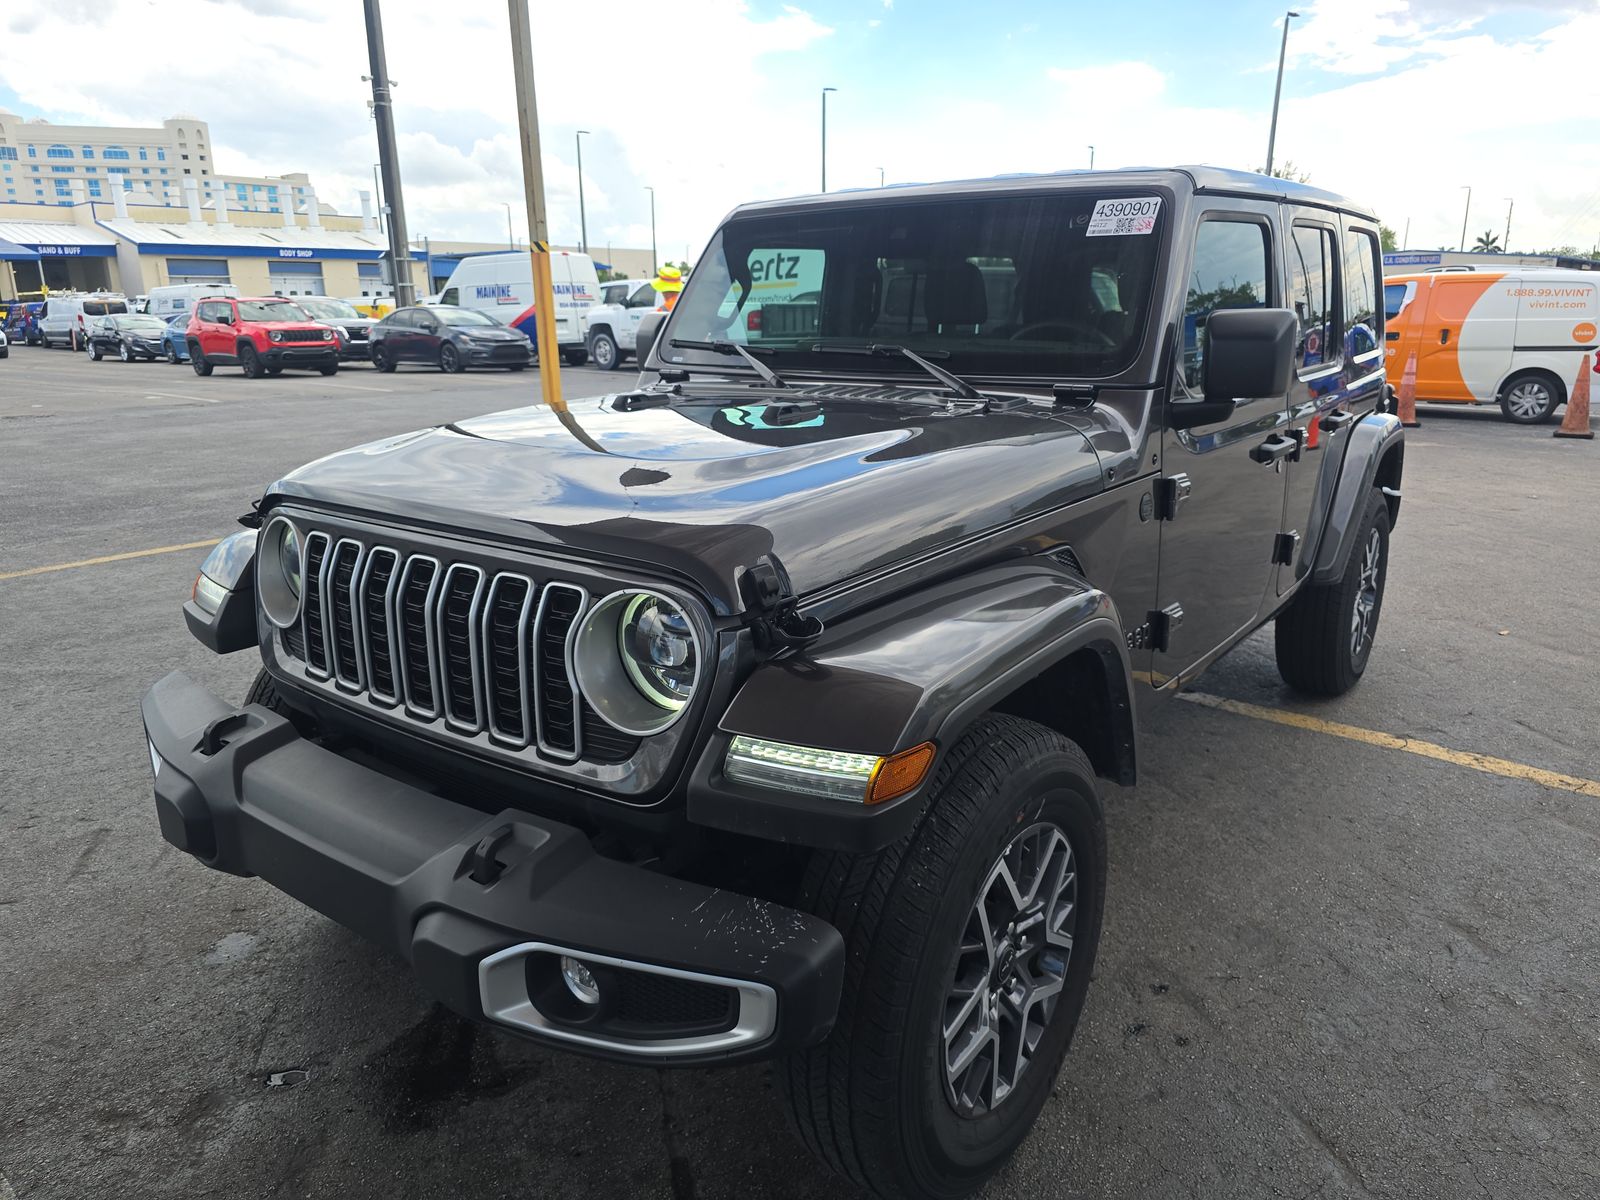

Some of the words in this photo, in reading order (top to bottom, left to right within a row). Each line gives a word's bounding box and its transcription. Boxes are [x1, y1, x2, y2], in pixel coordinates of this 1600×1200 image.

[1096, 201, 1159, 217] 4390901
[38, 246, 56, 254] SAND
[57, 246, 63, 255] &
[64, 247, 81, 255] BUFF
[280, 249, 296, 257] BODY
[750, 252, 800, 281] ertz
[1506, 288, 1592, 297] 1.888.99.VIVINT
